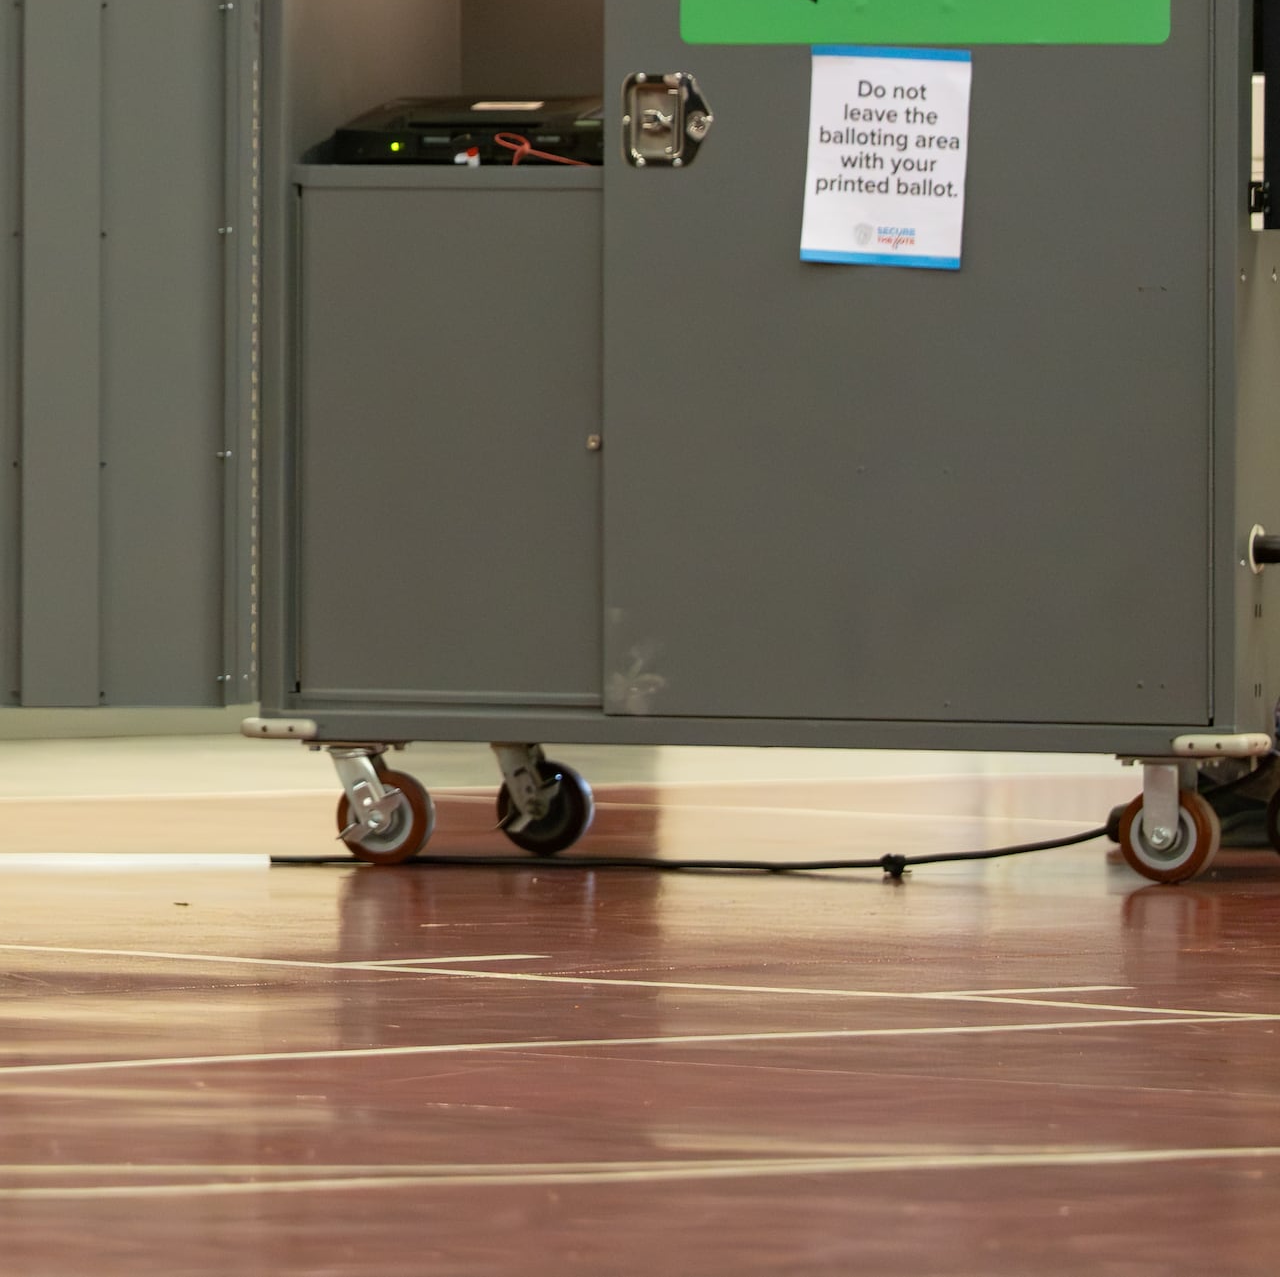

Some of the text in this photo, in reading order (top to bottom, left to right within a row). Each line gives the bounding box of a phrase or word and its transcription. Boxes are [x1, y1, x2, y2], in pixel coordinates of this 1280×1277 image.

[857, 80, 927, 100] Do not
[844, 103, 938, 125] leave the
[819, 126, 960, 152] balloting area
[841, 151, 937, 175] with your
[815, 175, 958, 198] printed ballot.
